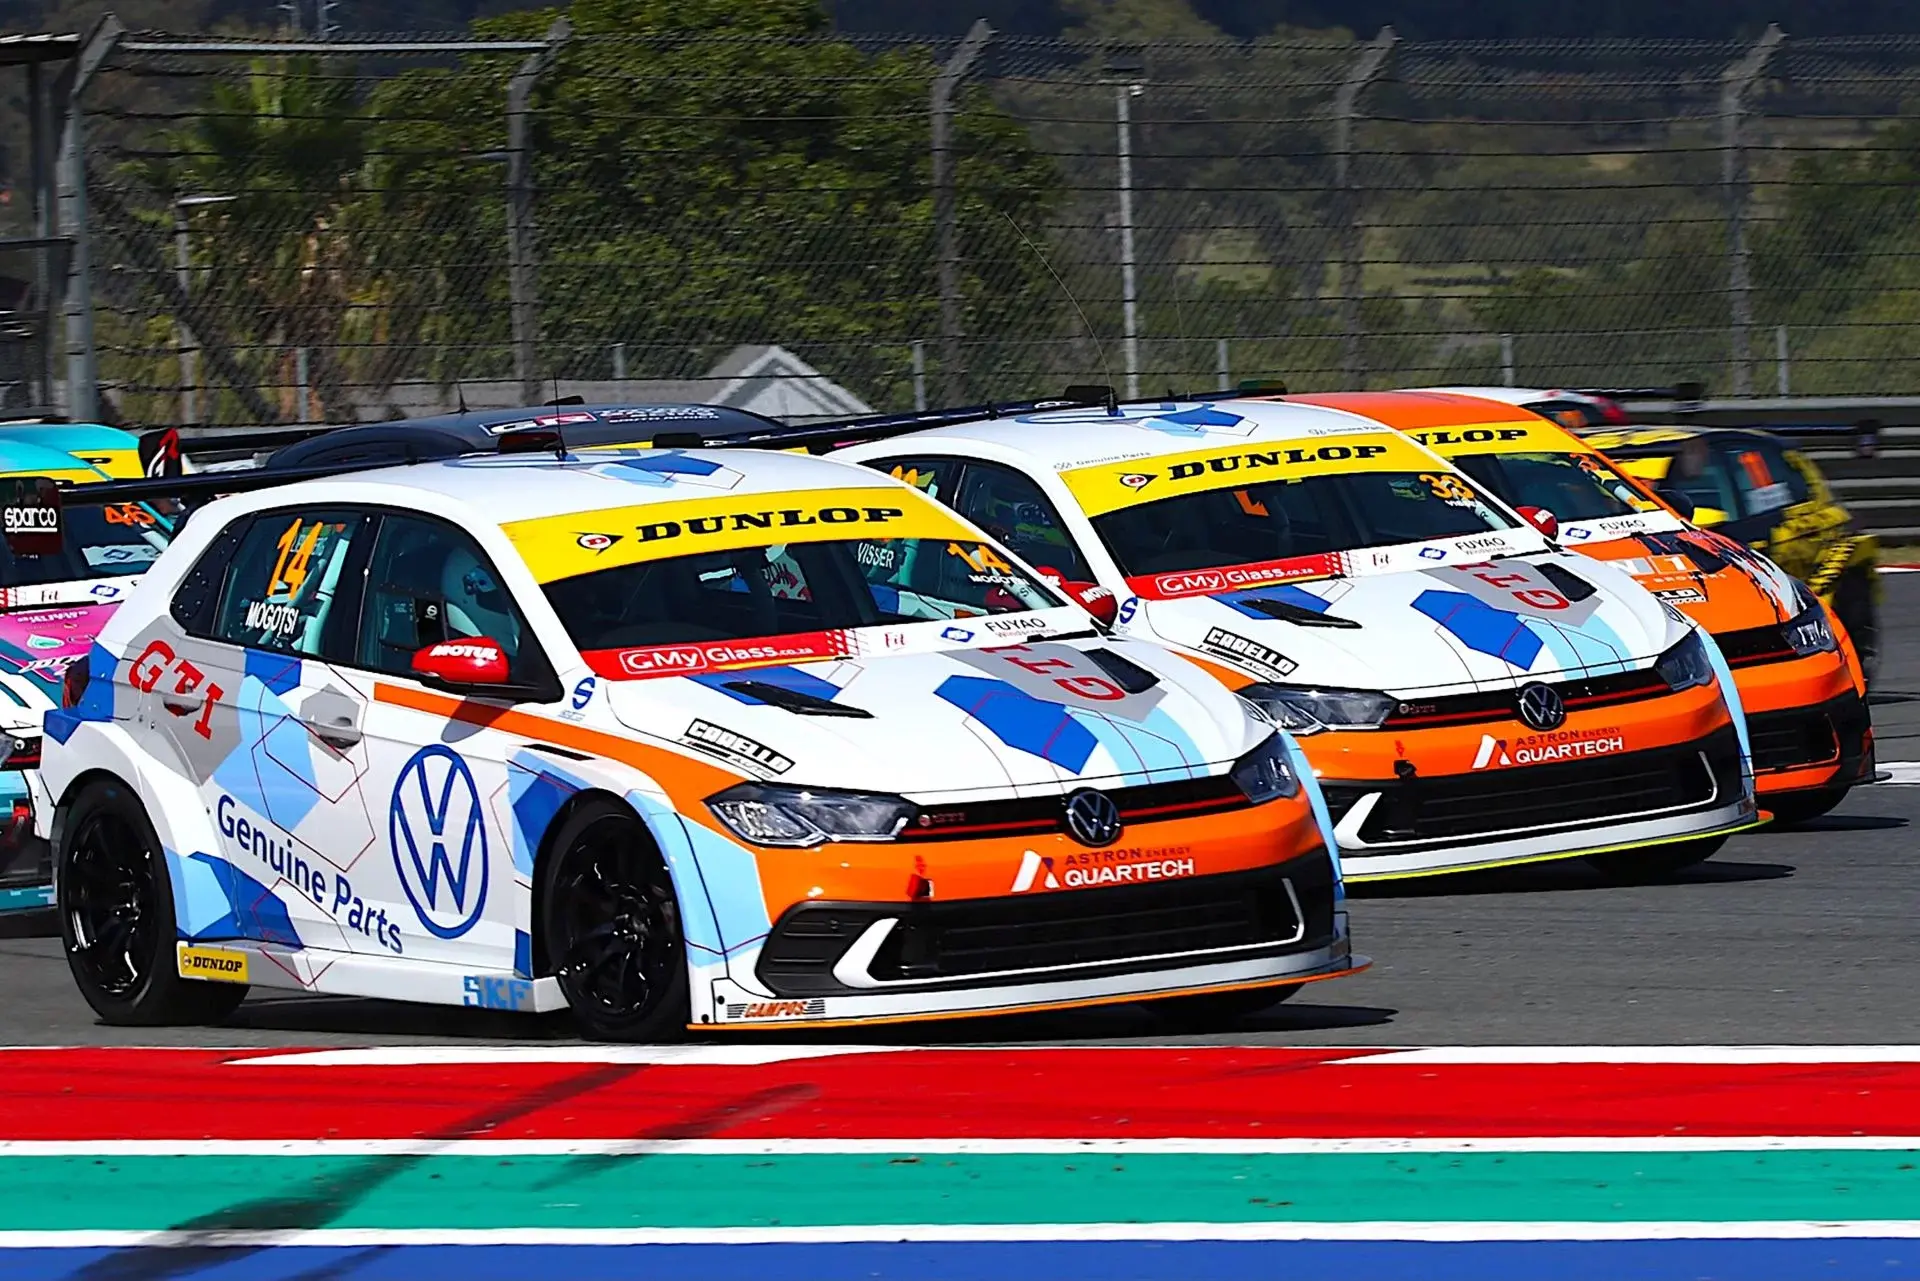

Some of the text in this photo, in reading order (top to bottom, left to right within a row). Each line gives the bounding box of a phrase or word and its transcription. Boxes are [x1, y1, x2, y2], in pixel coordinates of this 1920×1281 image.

[1412, 429, 1528, 447] NLOP
[1168, 445, 1387, 481] DUNLOP
[1418, 473, 1475, 499] 33
[4, 507, 57, 533] sparco
[104, 503, 155, 526] 46
[636, 507, 903, 543] DUNLOP
[1599, 519, 1646, 532] FUYAO
[856, 542, 895, 569] VISSER
[1454, 536, 1506, 551] FUYAO
[267, 517, 324, 601] 14
[947, 542, 1013, 576] 14
[245, 600, 300, 637] MOGOTSI
[984, 616, 1047, 634] FUYAO
[429, 644, 498, 661] MOTUL
[1205, 627, 1296, 675] CARELLO
[128, 639, 225, 740] GTI
[1515, 729, 1580, 748] ASTRON
[1515, 736, 1624, 764] QUARTECH
[1065, 847, 1141, 866] ASTRON
[217, 794, 404, 955] Genuine Parts
[1064, 858, 1195, 887] QUARTECH
[192, 955, 244, 973] DUNLOP
[463, 975, 532, 1010] SKF
[743, 1001, 808, 1018] CAMPOS
